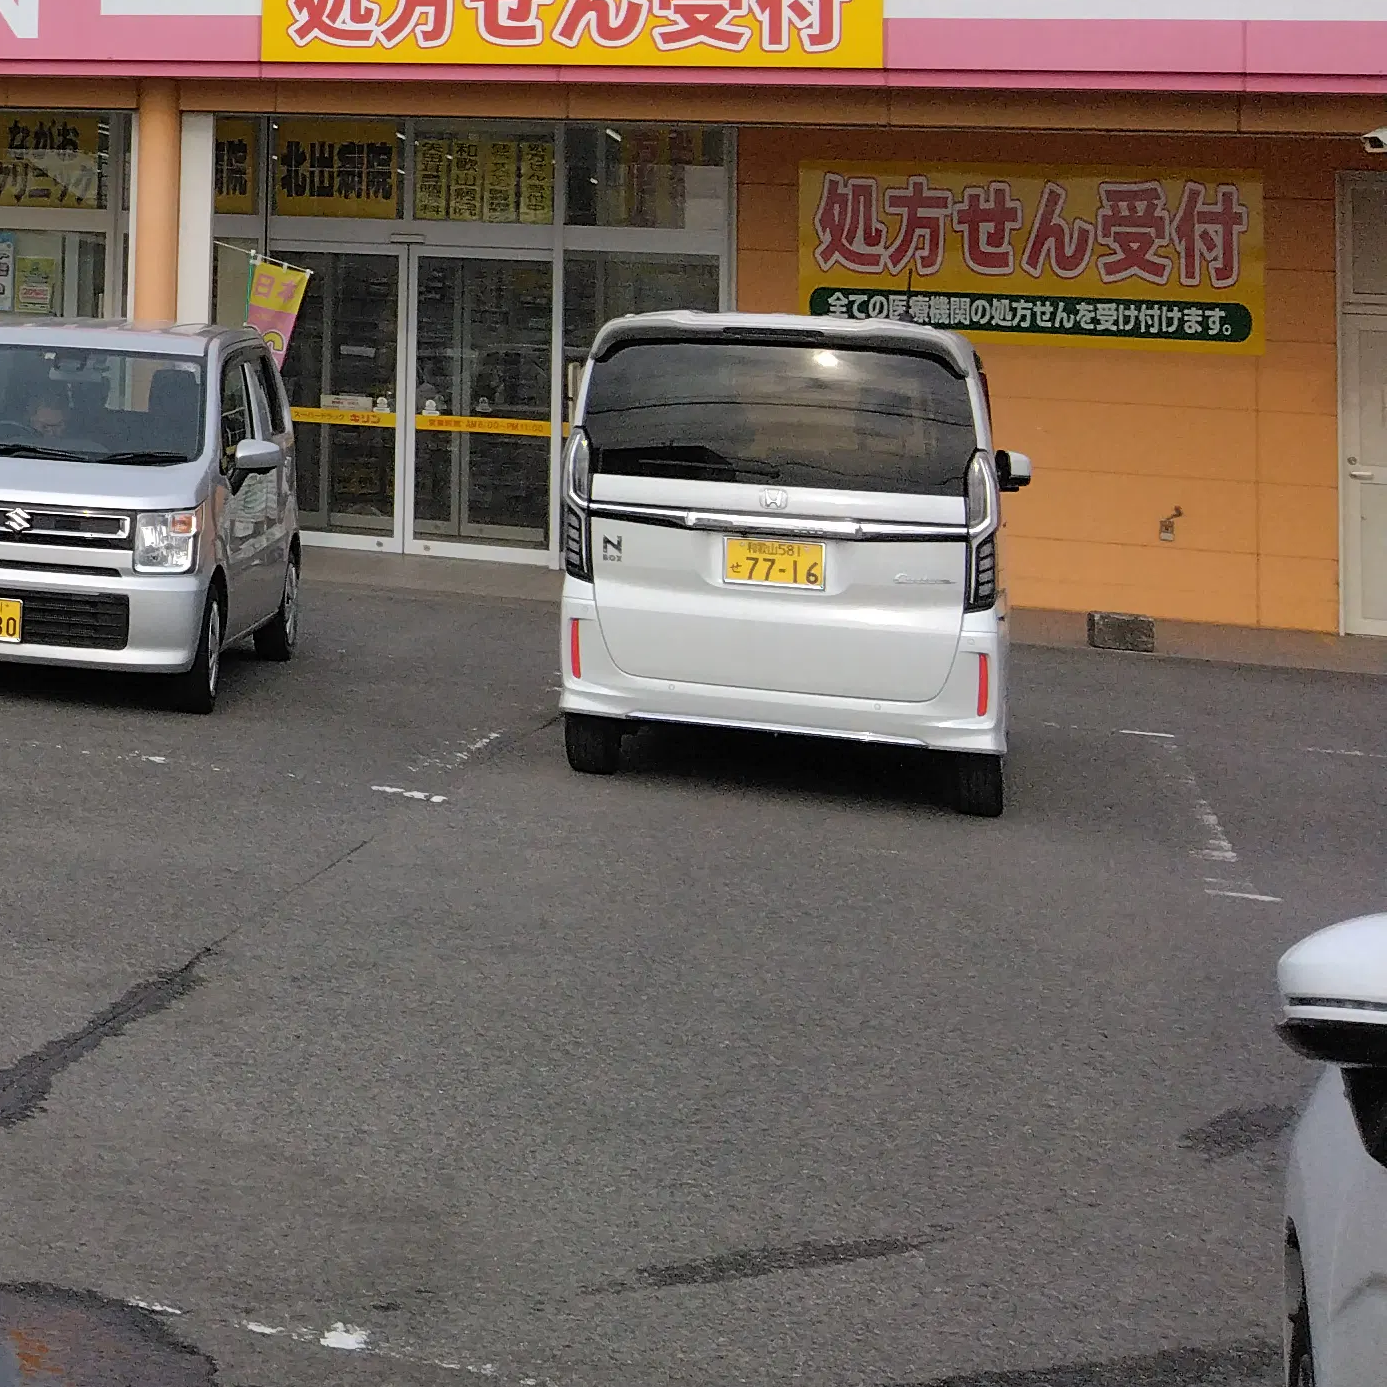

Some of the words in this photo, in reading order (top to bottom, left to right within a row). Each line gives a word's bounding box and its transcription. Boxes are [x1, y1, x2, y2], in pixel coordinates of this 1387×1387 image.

[815, 172, 1249, 289] 処方せん受付
[827, 292, 1232, 336] 全ての医療機関の処方せんを受け付けます。
[602, 553, 623, 563] BOX
[745, 556, 819, 585] 77-16
